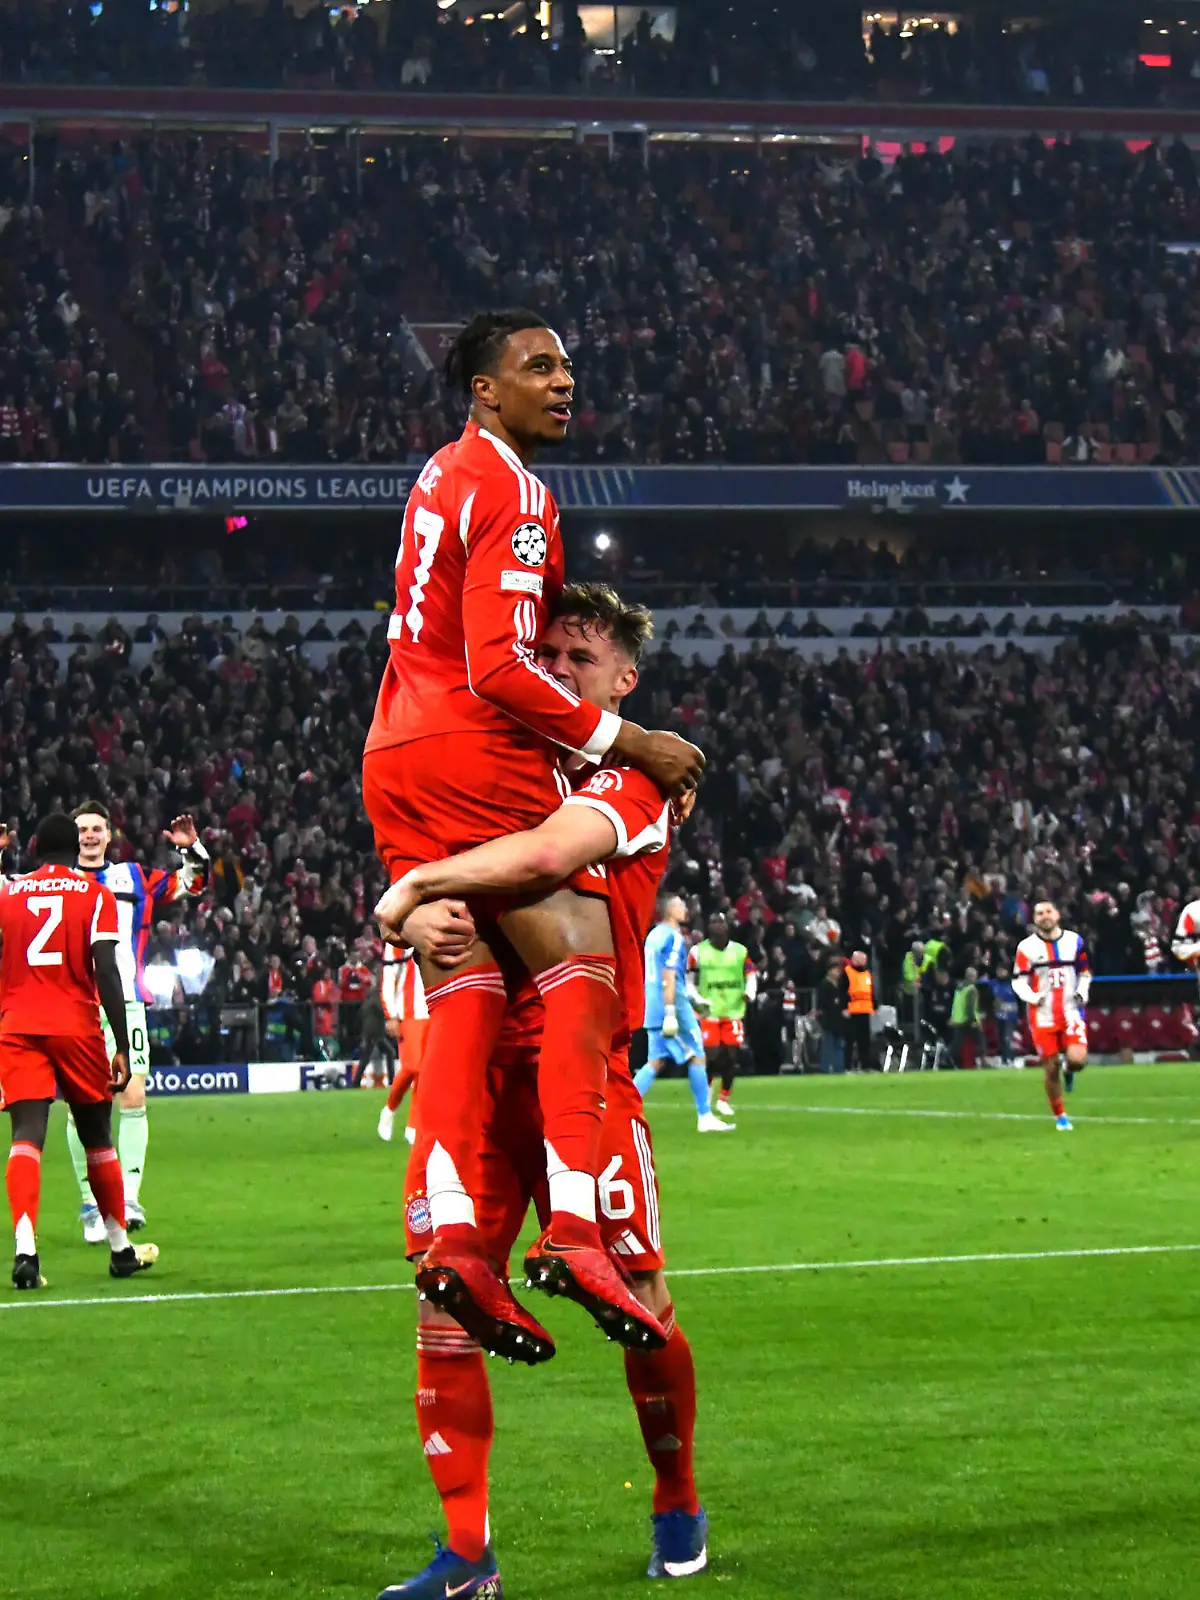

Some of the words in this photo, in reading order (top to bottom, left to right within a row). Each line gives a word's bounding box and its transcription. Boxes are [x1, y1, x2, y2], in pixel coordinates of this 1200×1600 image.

[87, 478, 151, 498] UEFA
[160, 478, 306, 498] CHAMPIONS
[316, 478, 409, 499] LEAGUE
[8, 877, 90, 896] UPAMECANO
[26, 894, 64, 967] 2
[145, 1071, 239, 1092] oto.com
[597, 1154, 636, 1221] 6
